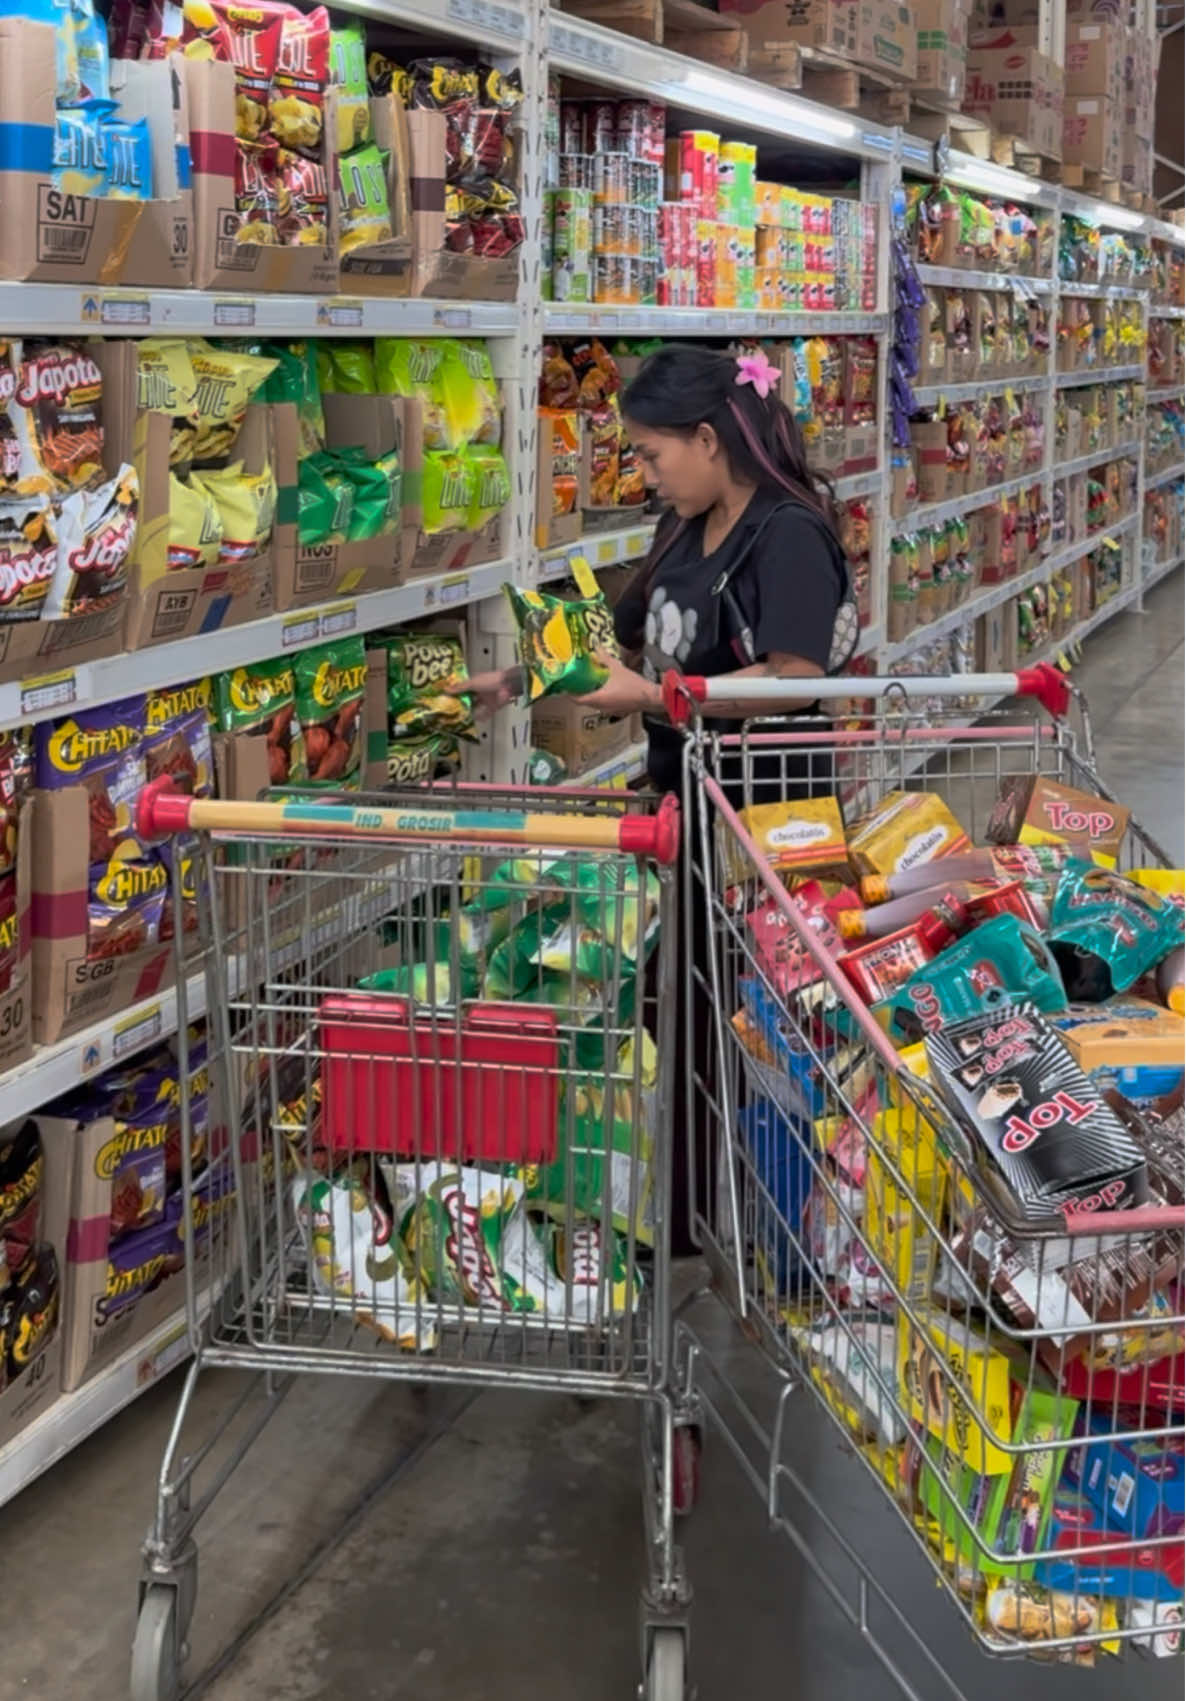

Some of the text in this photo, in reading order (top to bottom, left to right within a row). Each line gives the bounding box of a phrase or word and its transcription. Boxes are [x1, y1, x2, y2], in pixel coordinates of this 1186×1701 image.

[46, 190, 89, 222] SAT
[75, 958, 115, 984] SGB
[1, 998, 24, 1037] 30
